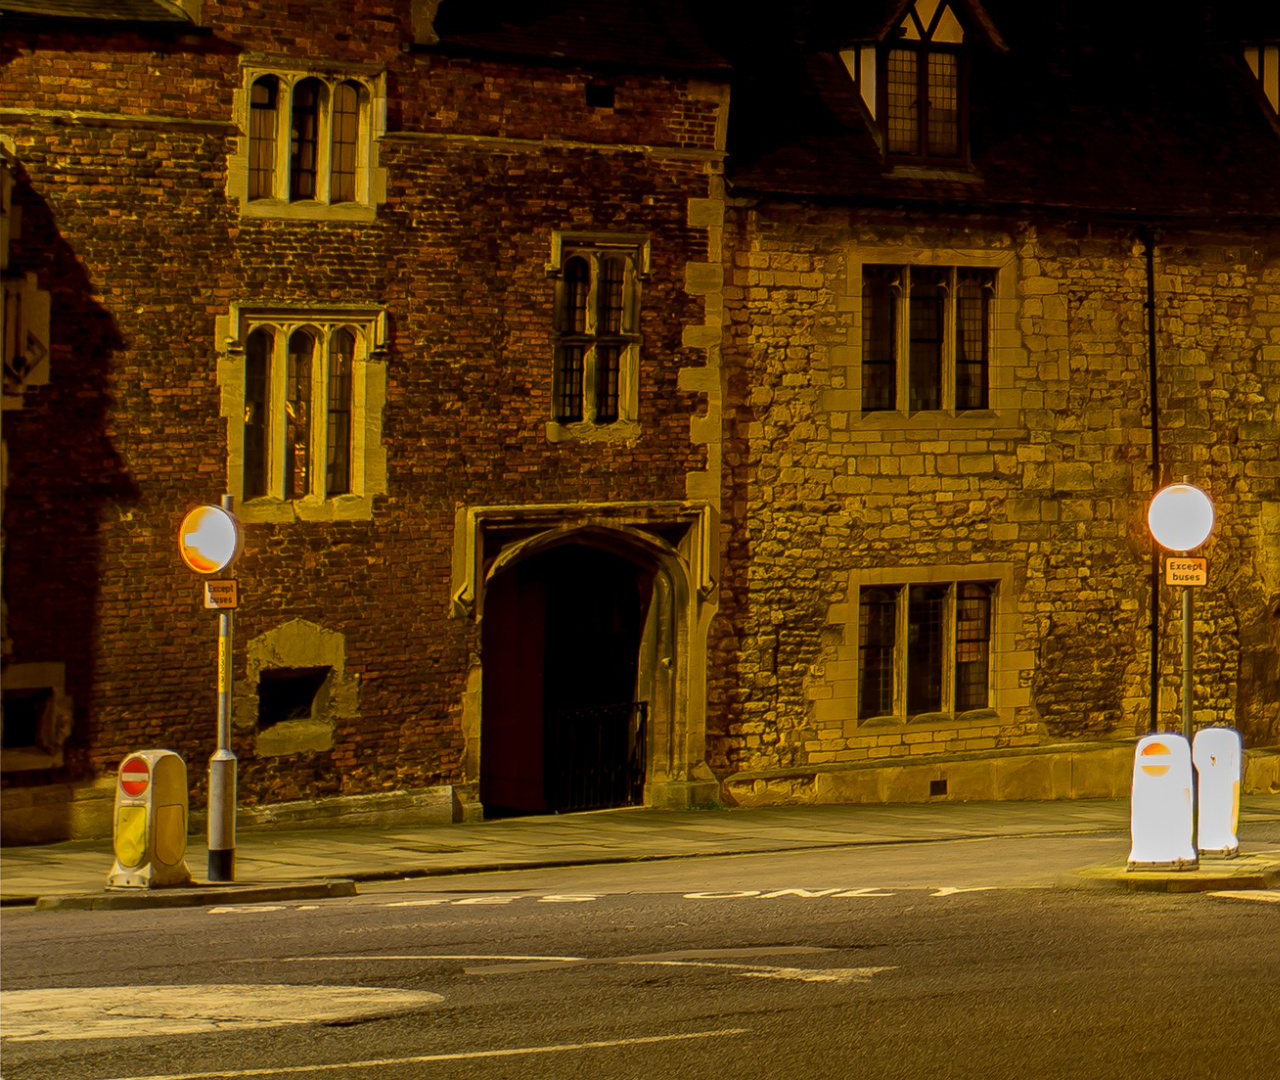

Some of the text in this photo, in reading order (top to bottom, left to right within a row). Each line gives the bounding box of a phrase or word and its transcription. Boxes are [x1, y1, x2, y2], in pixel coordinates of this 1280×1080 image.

[1170, 561, 1203, 571] Except
[1172, 572, 1201, 581] buses
[207, 584, 234, 594] Except
